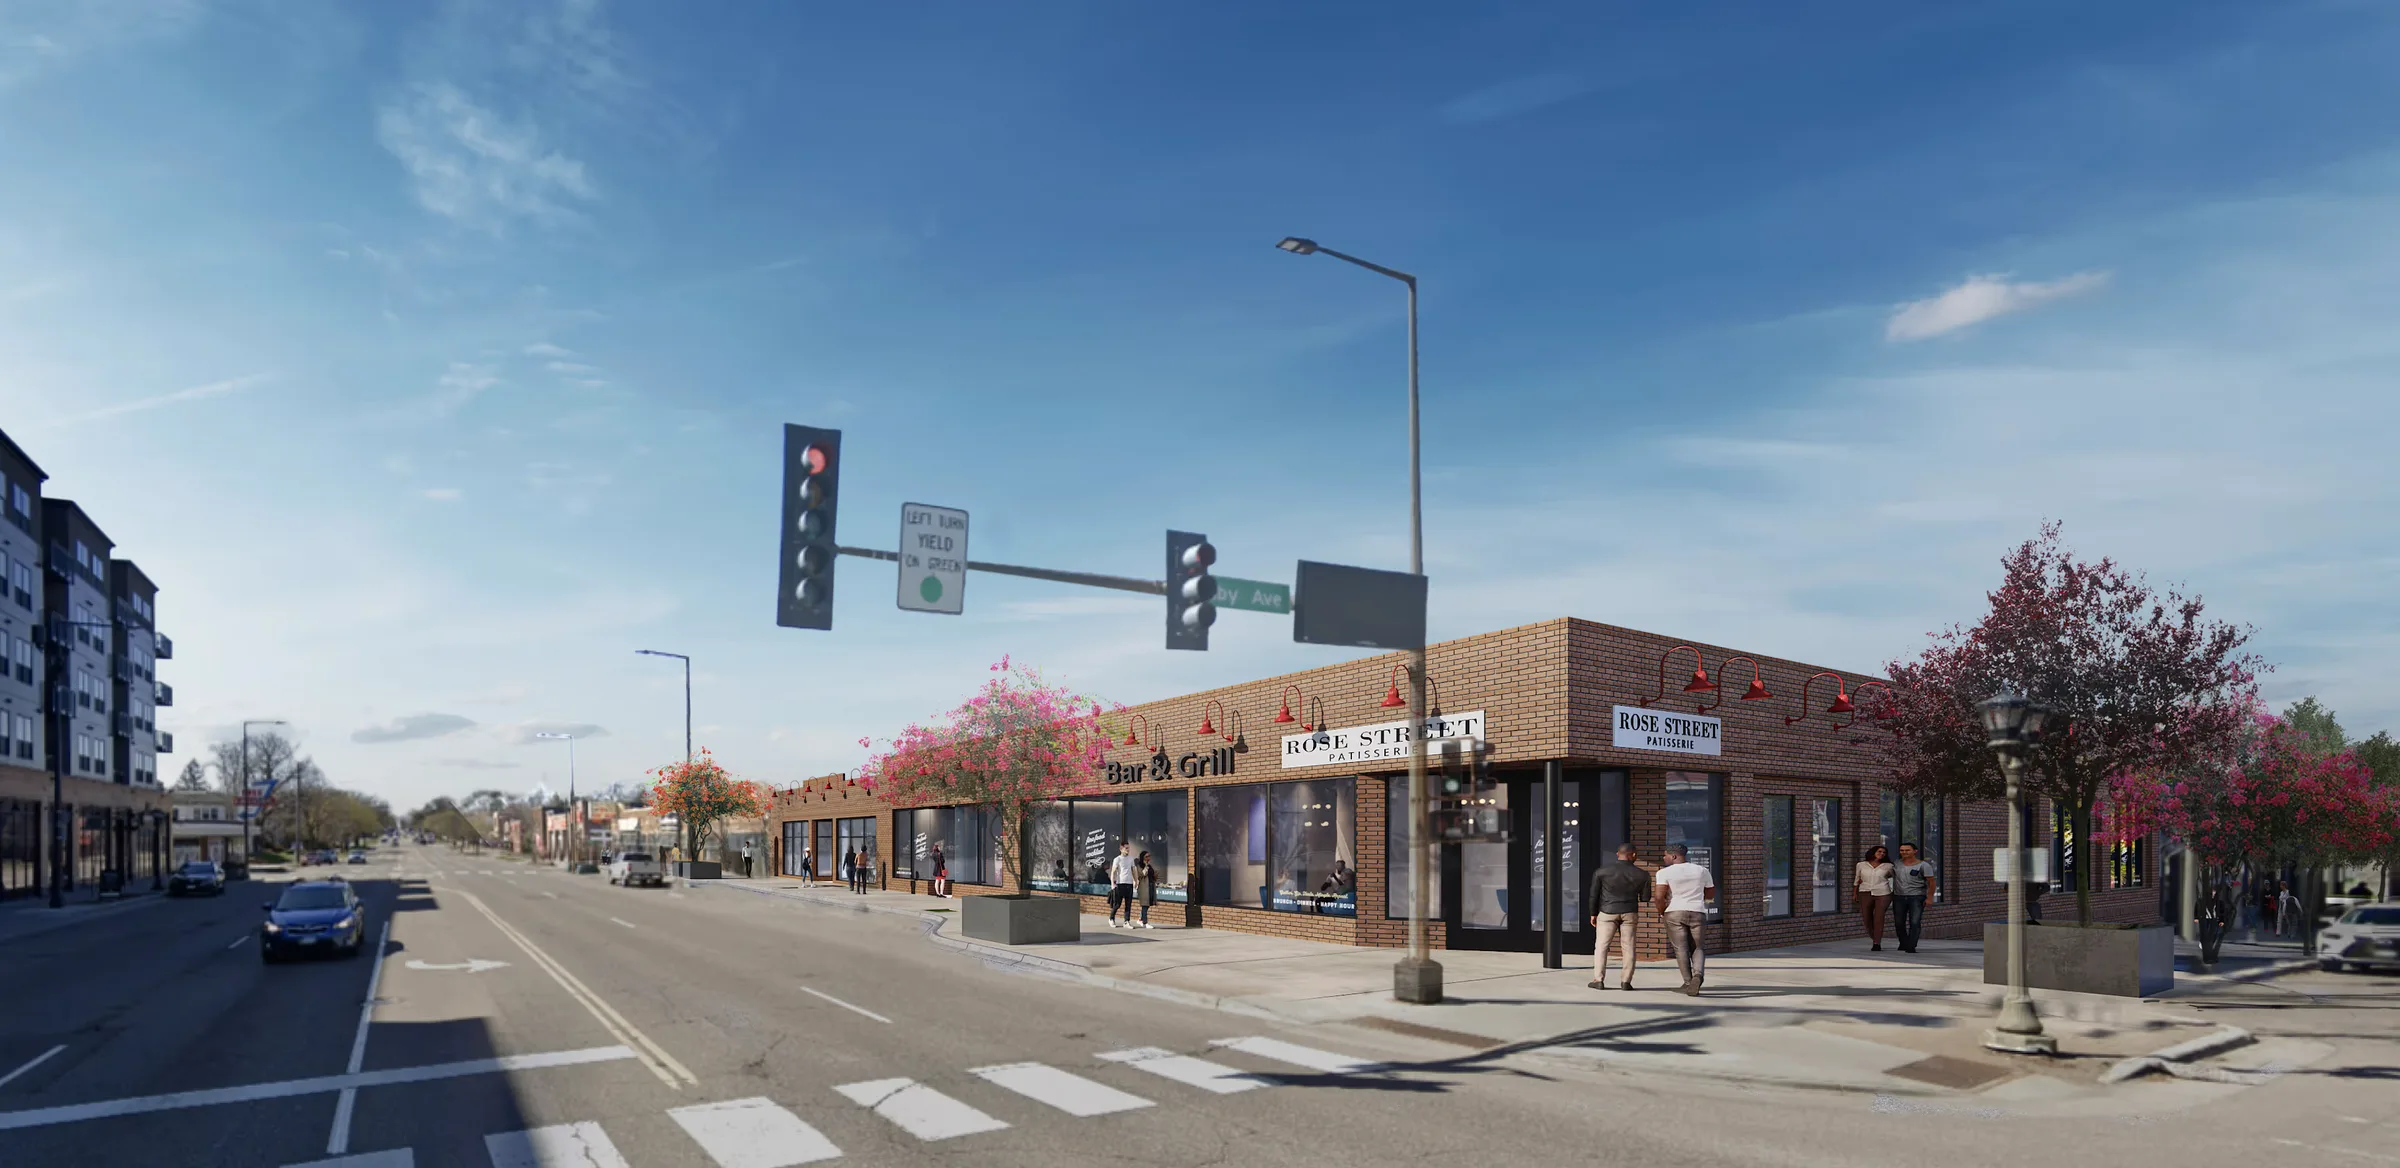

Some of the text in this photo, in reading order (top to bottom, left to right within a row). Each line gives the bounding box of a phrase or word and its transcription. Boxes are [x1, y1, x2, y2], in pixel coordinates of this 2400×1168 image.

[907, 511, 965, 529] LEFT TURN
[918, 533, 953, 552] YIELD
[906, 554, 961, 573] ON GREEN
[1253, 590, 1282, 608] Ave
[1619, 712, 1719, 739] ROSE STREET
[1286, 718, 1478, 755] ROSE STREET
[1647, 736, 1694, 750] PATISSERIE
[1329, 746, 1418, 762] PATISSERIE
[1105, 747, 1235, 785] Bar & Grill
[1339, 902, 1355, 910] HOUR
